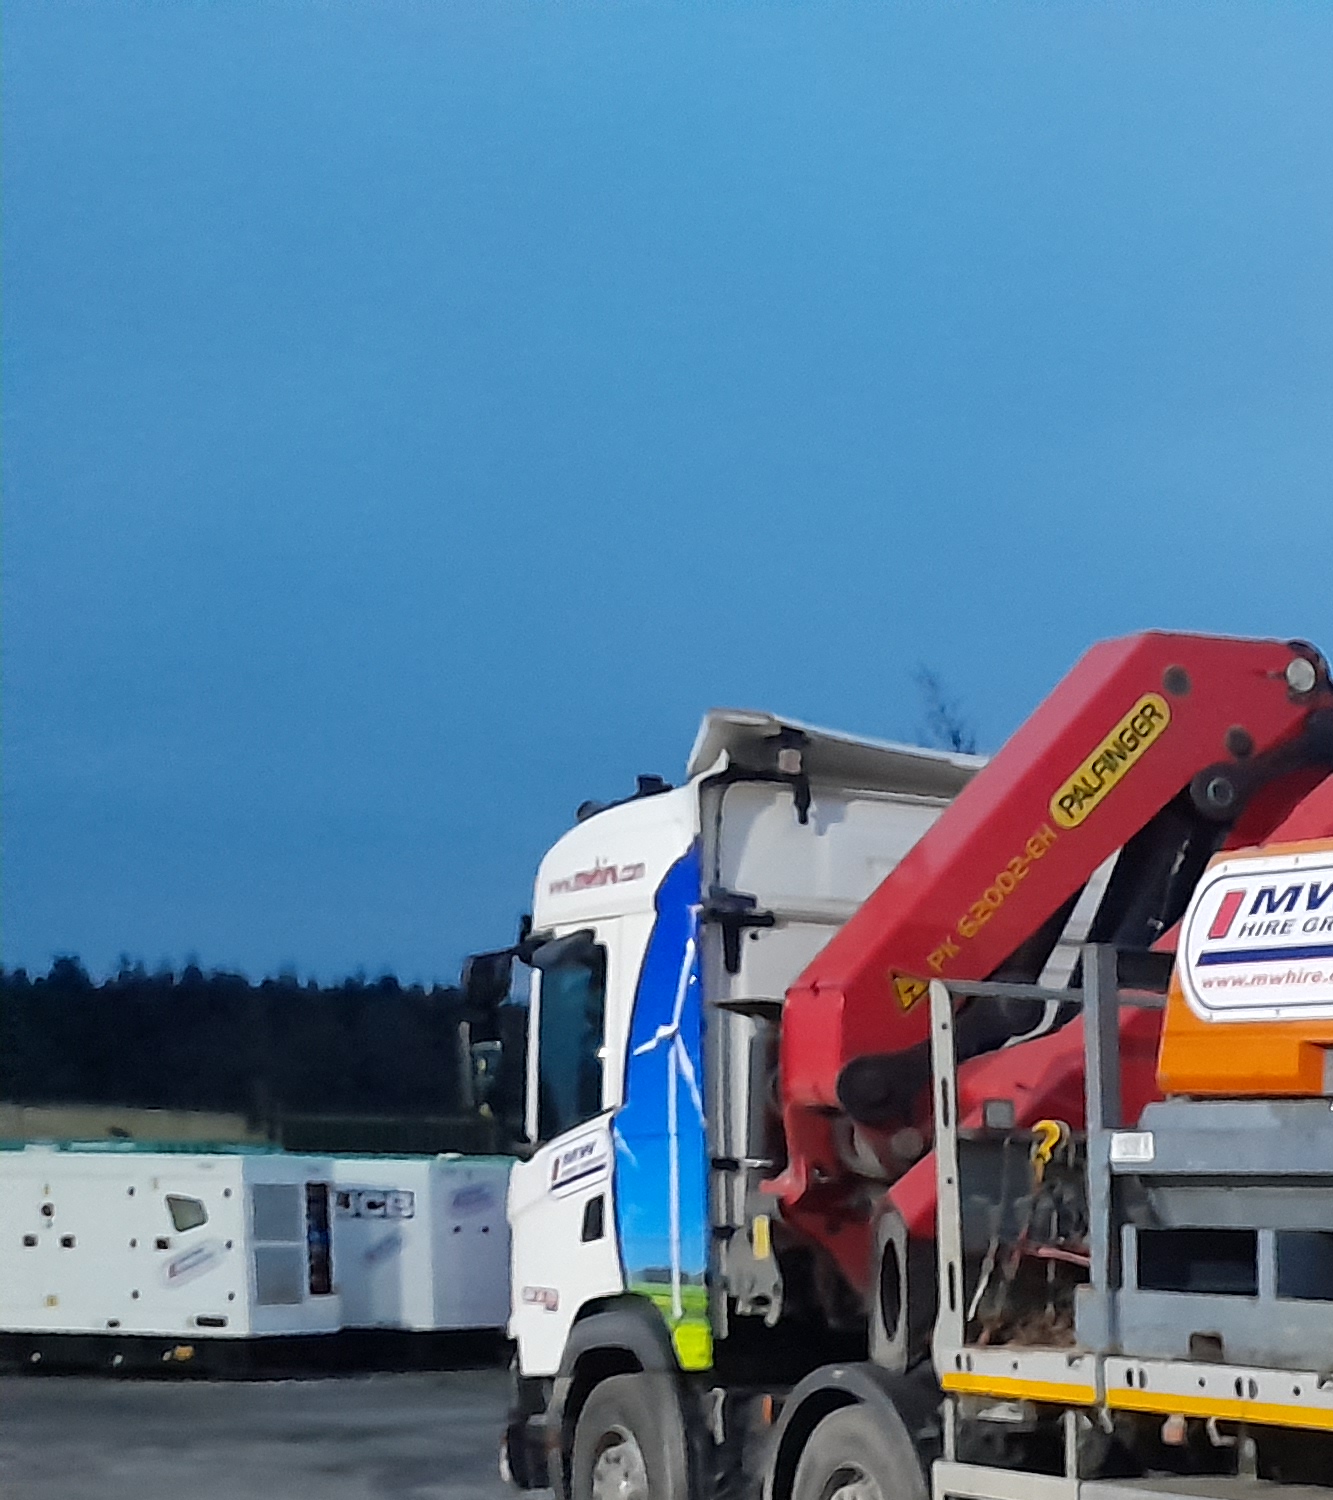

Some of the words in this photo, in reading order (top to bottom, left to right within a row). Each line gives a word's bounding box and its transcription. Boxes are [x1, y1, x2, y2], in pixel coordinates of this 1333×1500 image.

[1057, 702, 1164, 820] PALFINGER
[926, 936, 960, 972] PK
[957, 823, 1058, 939] 62002-EH
[1238, 918, 1297, 939] HIRE
